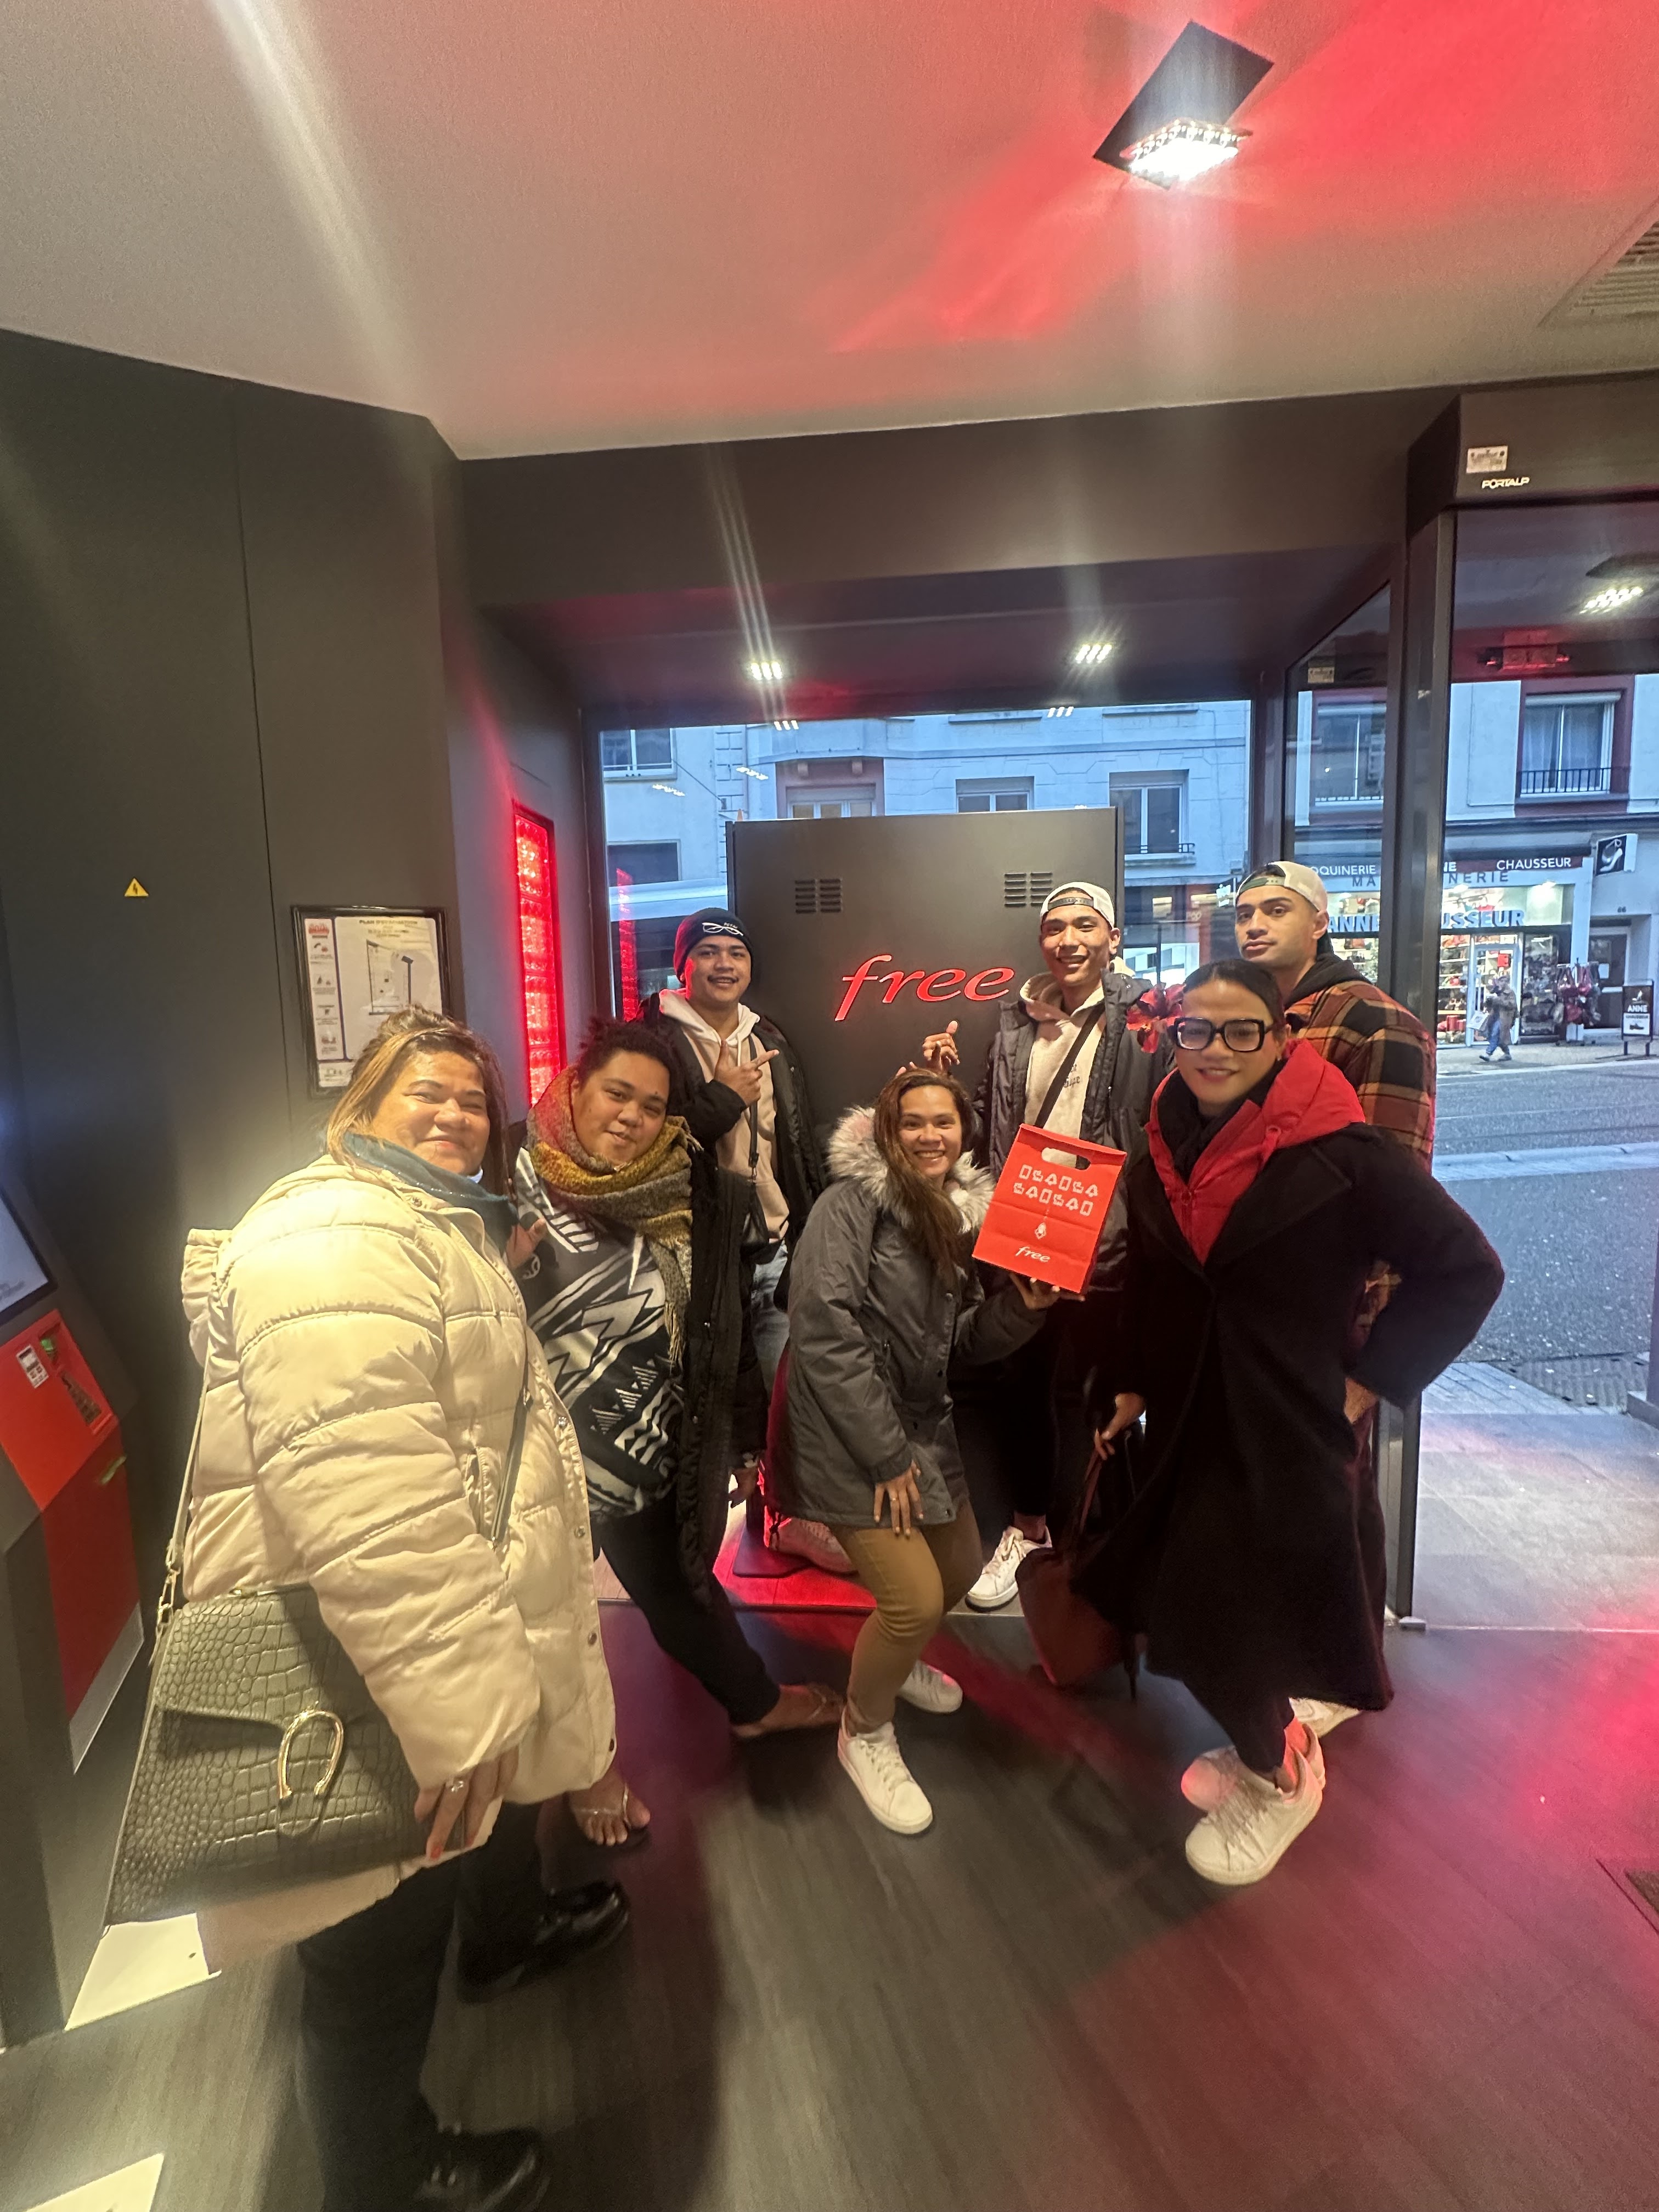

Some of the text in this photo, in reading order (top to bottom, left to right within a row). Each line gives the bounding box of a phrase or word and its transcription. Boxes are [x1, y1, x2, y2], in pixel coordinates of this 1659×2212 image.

[1482, 477, 1530, 489] PORTALP
[1496, 857, 1571, 871] CHAUSSEUR
[834, 954, 1014, 1022] free
[1627, 1005, 1648, 1013] ANNE
[1014, 1246, 1051, 1263] free
